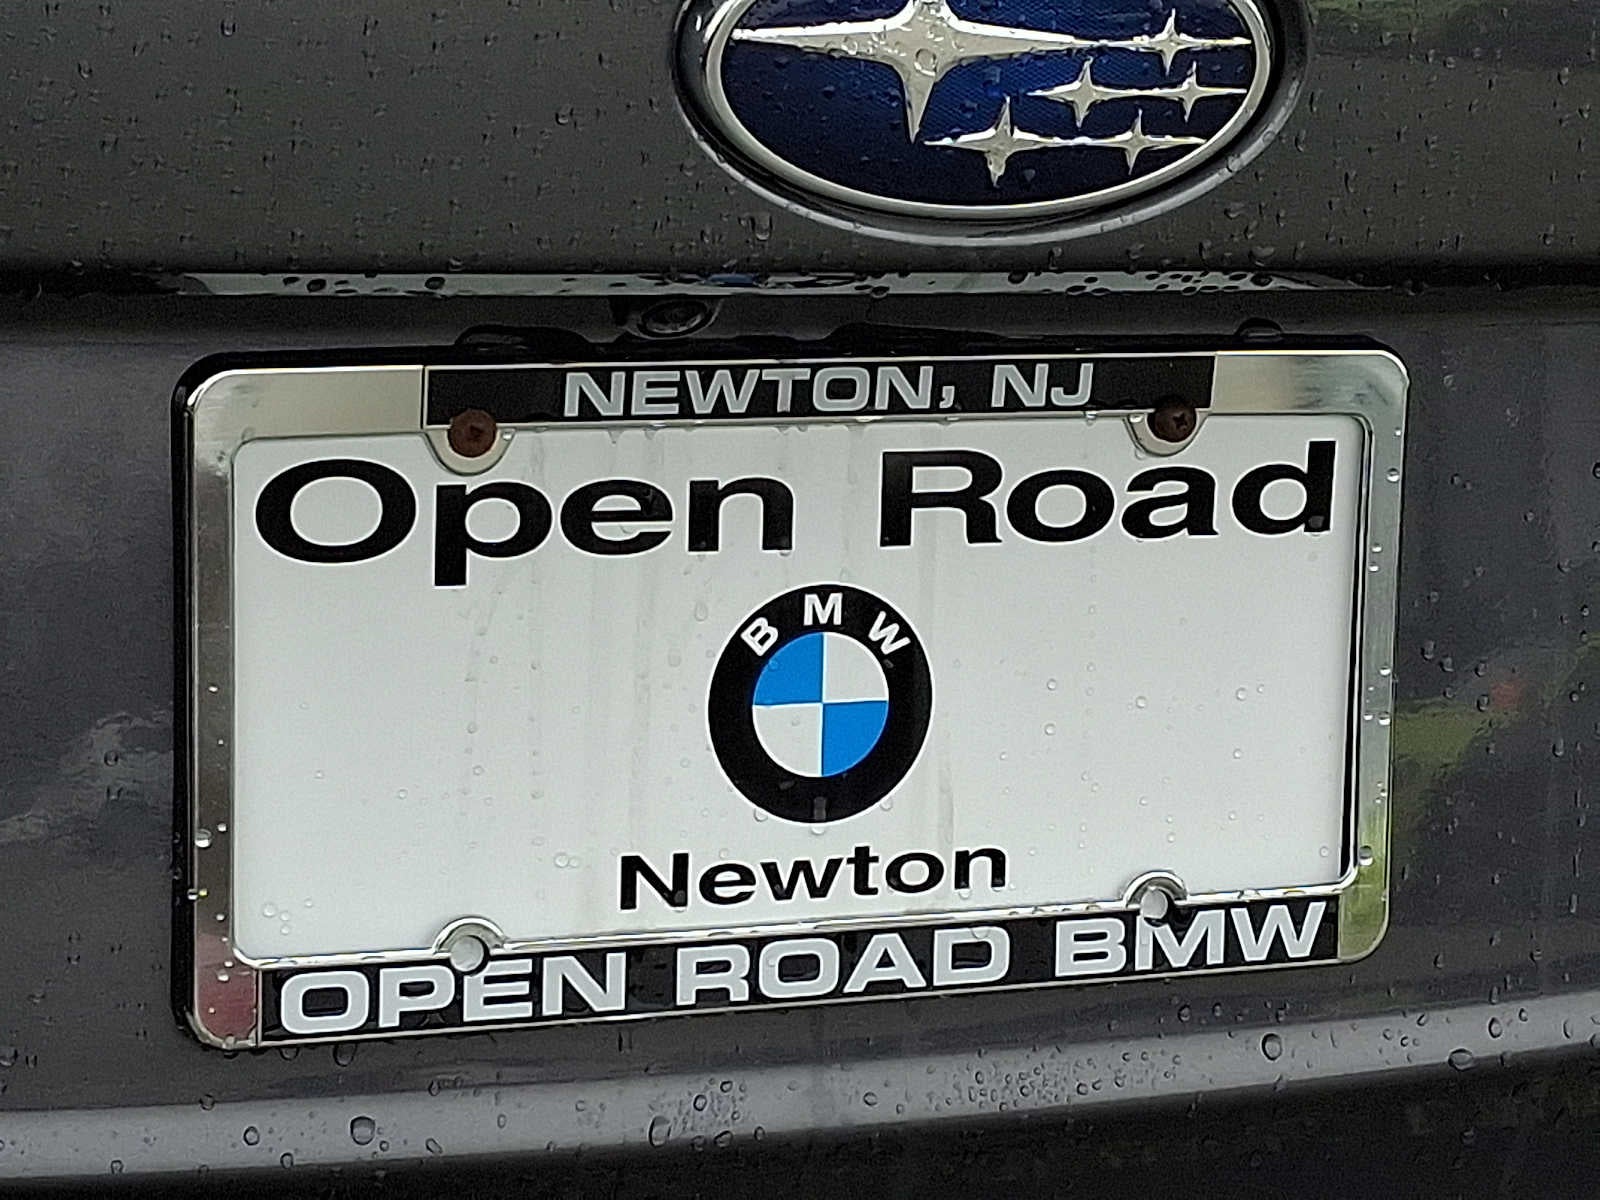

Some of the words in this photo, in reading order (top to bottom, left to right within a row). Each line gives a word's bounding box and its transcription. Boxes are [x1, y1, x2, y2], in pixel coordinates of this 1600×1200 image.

[563, 366, 955, 417] NEWTON,
[992, 363, 1094, 408] NJ
[255, 458, 794, 587] Open
[881, 440, 1336, 545] Road
[741, 592, 910, 656] BMW
[620, 846, 1008, 910] Newton
[279, 951, 628, 1035] OPEN
[675, 925, 1010, 1006] ROAD
[1054, 901, 1328, 978] BMW
